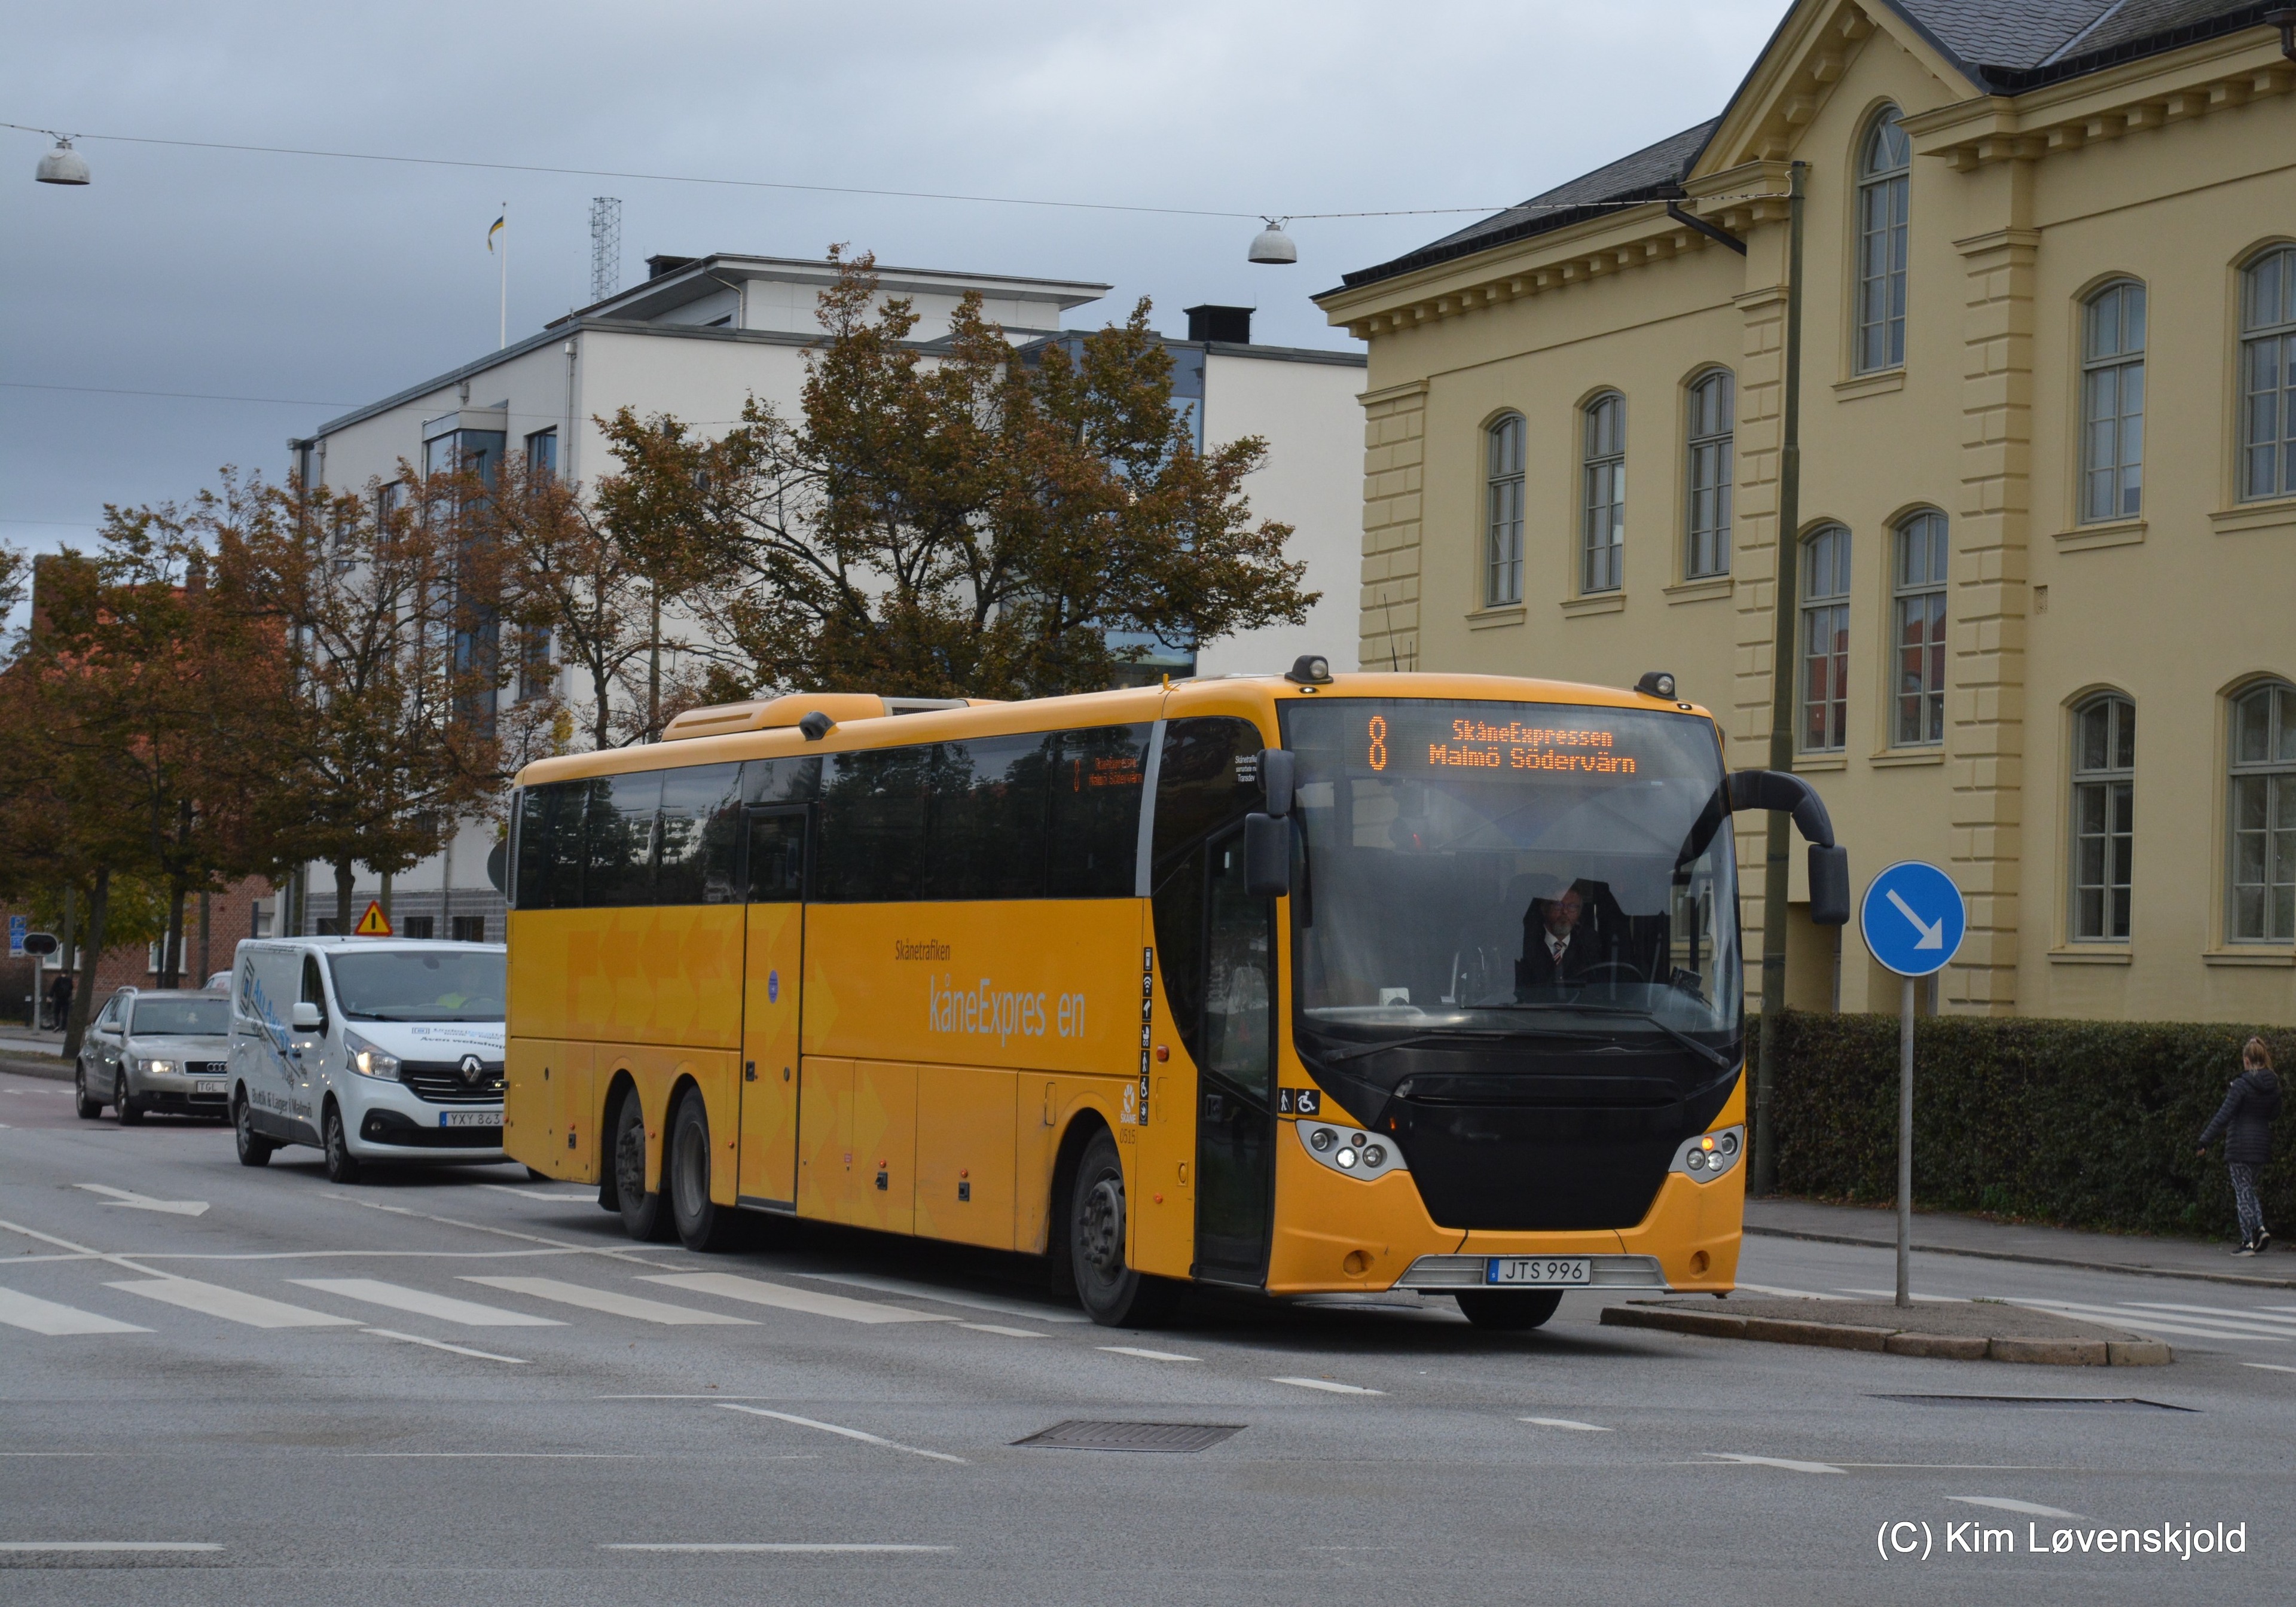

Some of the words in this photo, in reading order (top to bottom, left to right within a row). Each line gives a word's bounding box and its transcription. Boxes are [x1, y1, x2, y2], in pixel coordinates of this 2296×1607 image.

[1369, 716, 1387, 771] 8
[1453, 719, 1613, 747] SkåneExpressen
[1430, 744, 1501, 768] Malmö
[1510, 748, 1636, 773] Södervärn
[1238, 774, 1255, 782] Transdev
[896, 937, 951, 961] Skånetrafiken
[200, 1083, 216, 1092] TGL
[252, 1088, 267, 1106] Butik
[272, 1093, 288, 1114] Lager
[292, 1098, 312, 1118] Malmö
[1119, 1128, 1135, 1144] 0515
[1506, 1262, 1540, 1279] JTS
[1547, 1262, 1583, 1279] 996
